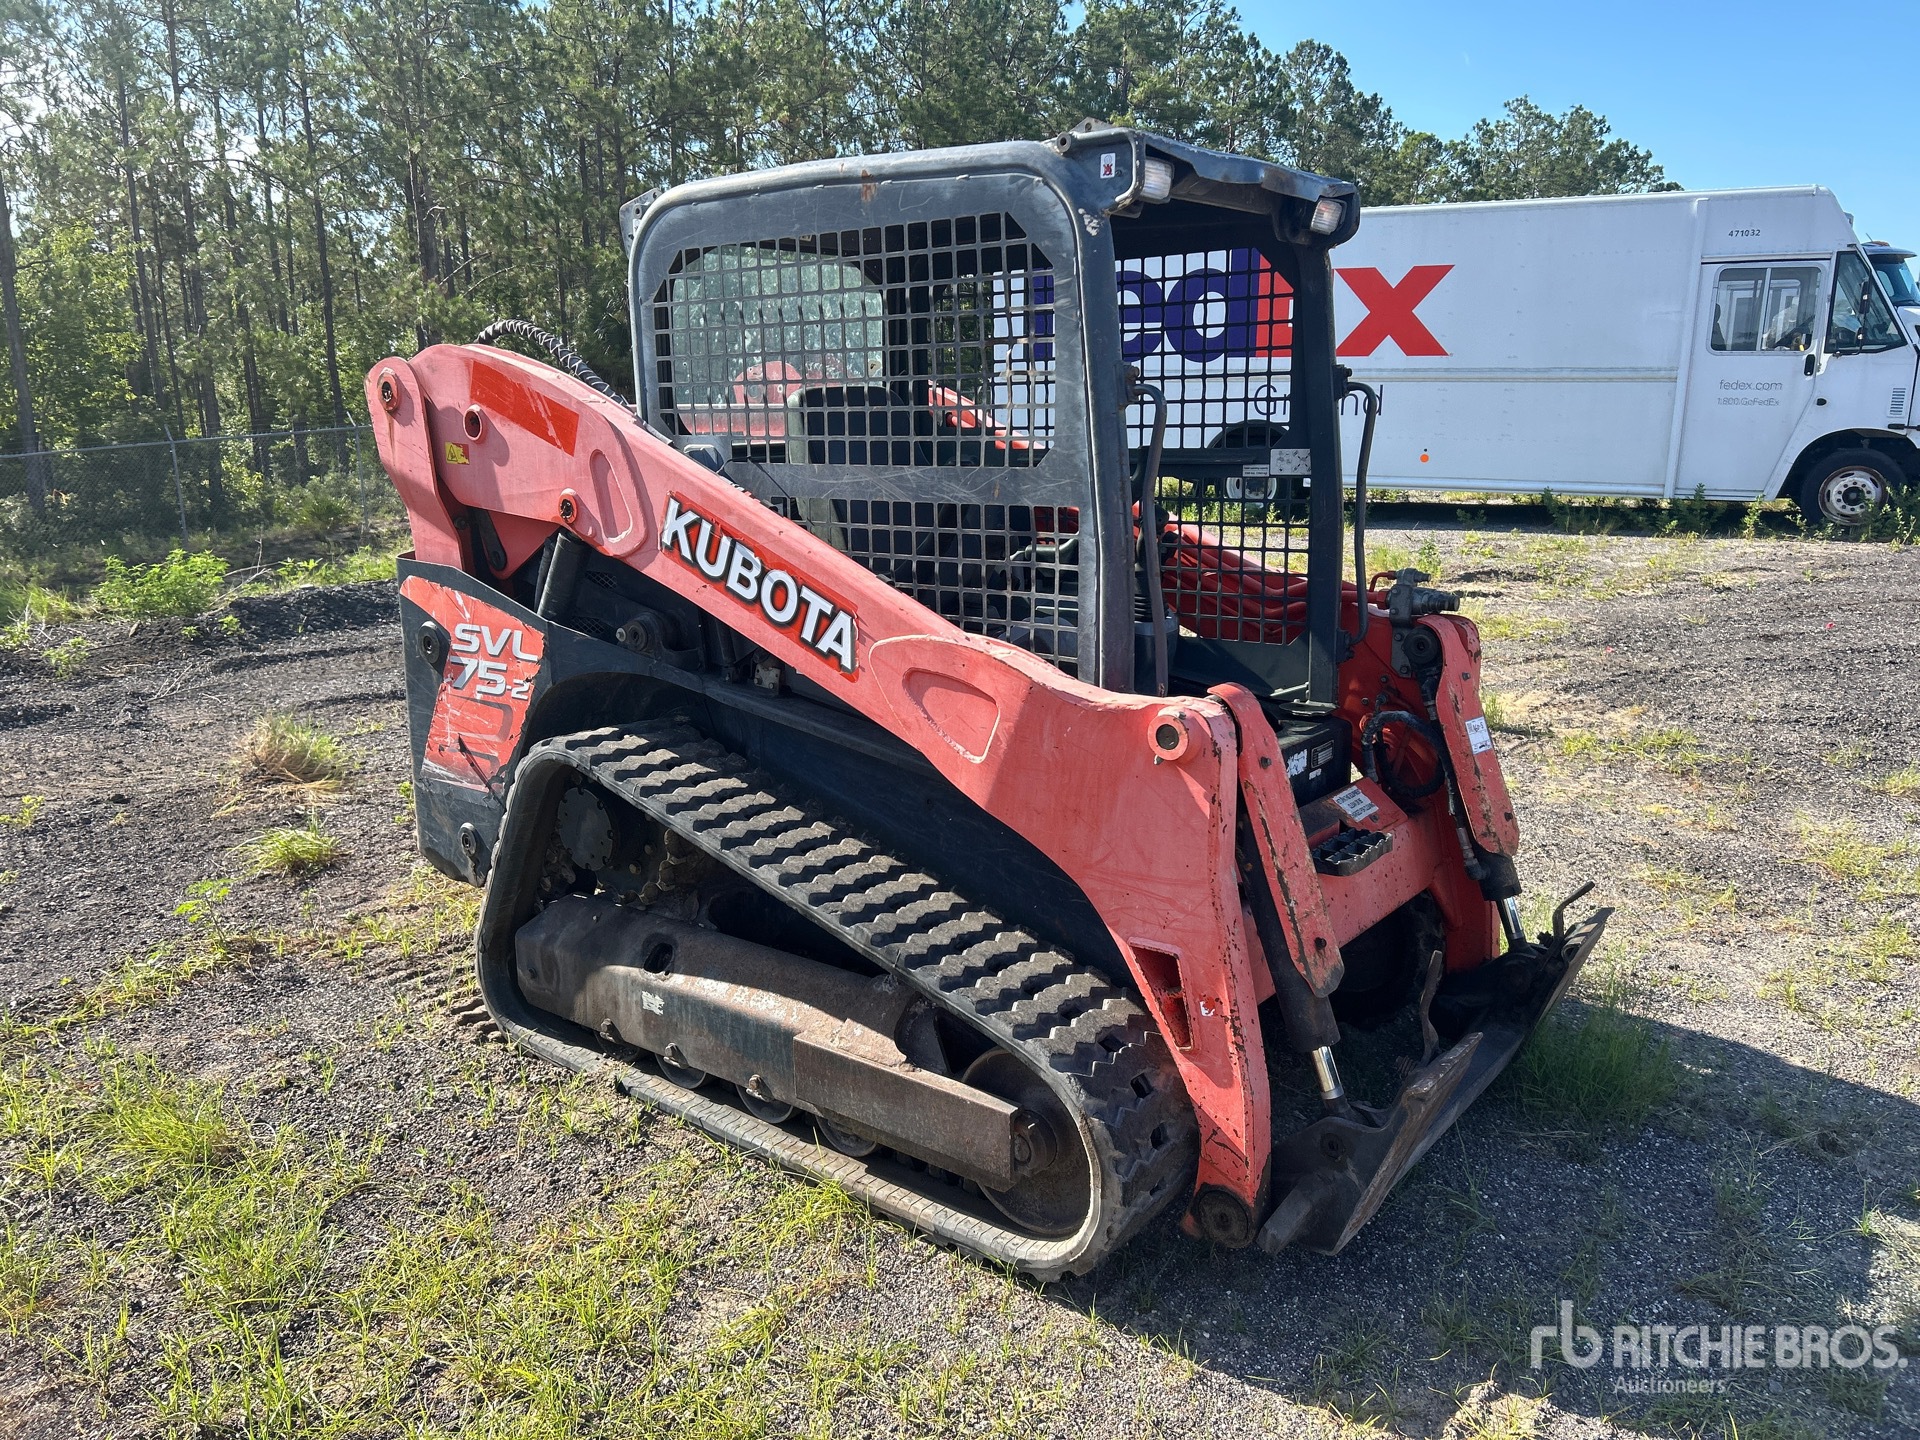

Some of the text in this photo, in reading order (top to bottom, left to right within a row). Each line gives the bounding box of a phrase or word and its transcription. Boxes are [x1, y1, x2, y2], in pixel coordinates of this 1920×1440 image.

[1728, 229, 1761, 237] 471032
[1253, 384, 1383, 416] Grnd
[1719, 379, 1783, 391] fedex.com
[661, 498, 854, 672] KUBOTA
[452, 622, 539, 662] SVL
